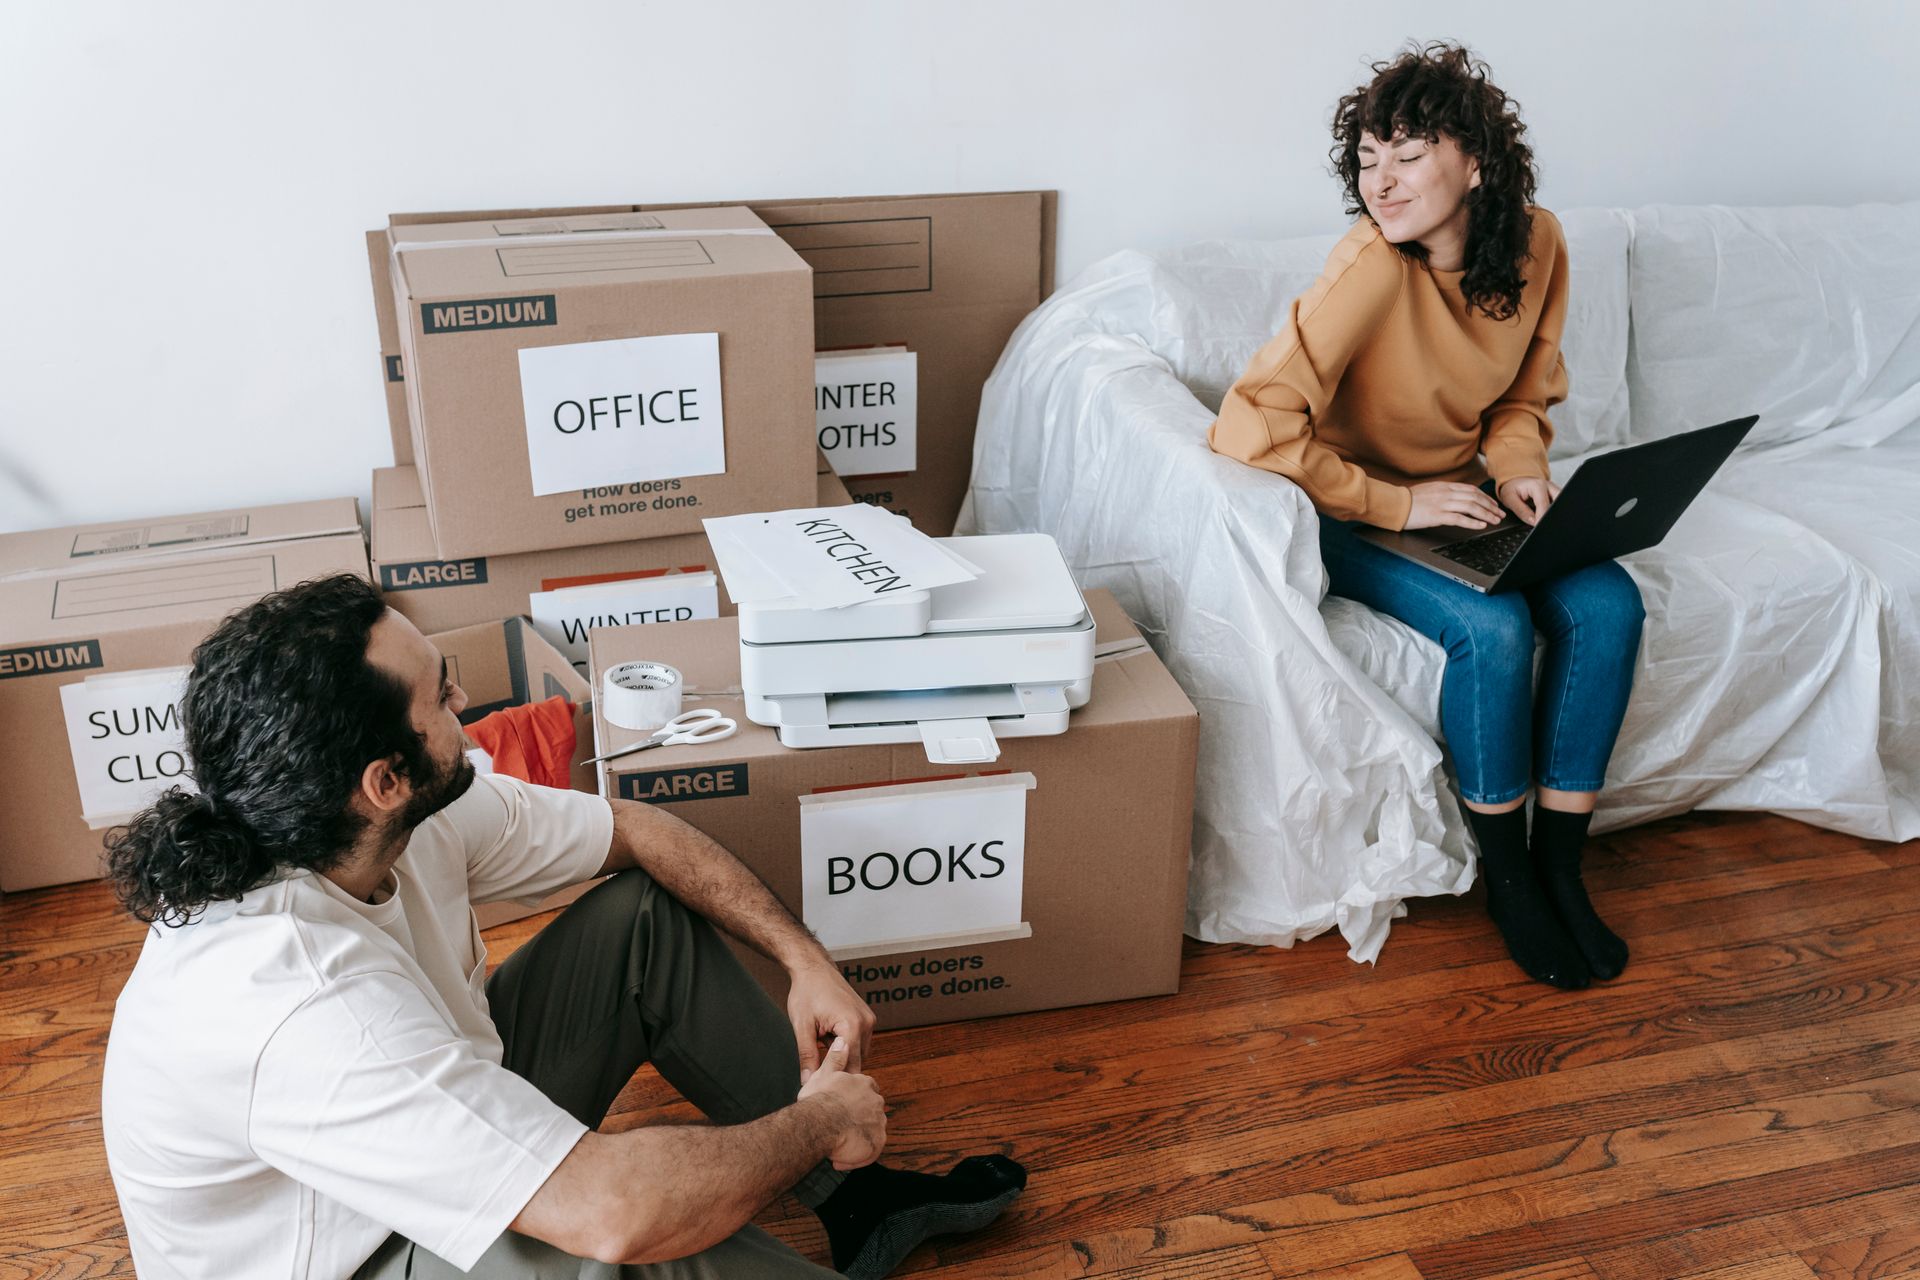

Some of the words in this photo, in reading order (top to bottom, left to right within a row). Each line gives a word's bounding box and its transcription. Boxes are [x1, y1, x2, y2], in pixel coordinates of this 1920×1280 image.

[433, 301, 546, 328] MEDIUM
[553, 388, 700, 434] OFFICE
[815, 381, 896, 411] INTER
[818, 421, 897, 451] OTHS
[583, 484, 624, 500] How
[629, 479, 682, 495] doers
[564, 503, 595, 523] get
[600, 500, 647, 516] more
[796, 518, 912, 594] KITCHEN
[391, 562, 477, 587] LARGE
[0, 645, 91, 674] EDIUM
[88, 703, 180, 739] SUM
[107, 750, 186, 783] CLO
[632, 770, 736, 800] LARGE
[827, 840, 1006, 896] BOOKS
[844, 964, 902, 984] How
[909, 955, 984, 977] doers
[865, 986, 933, 1005] more
